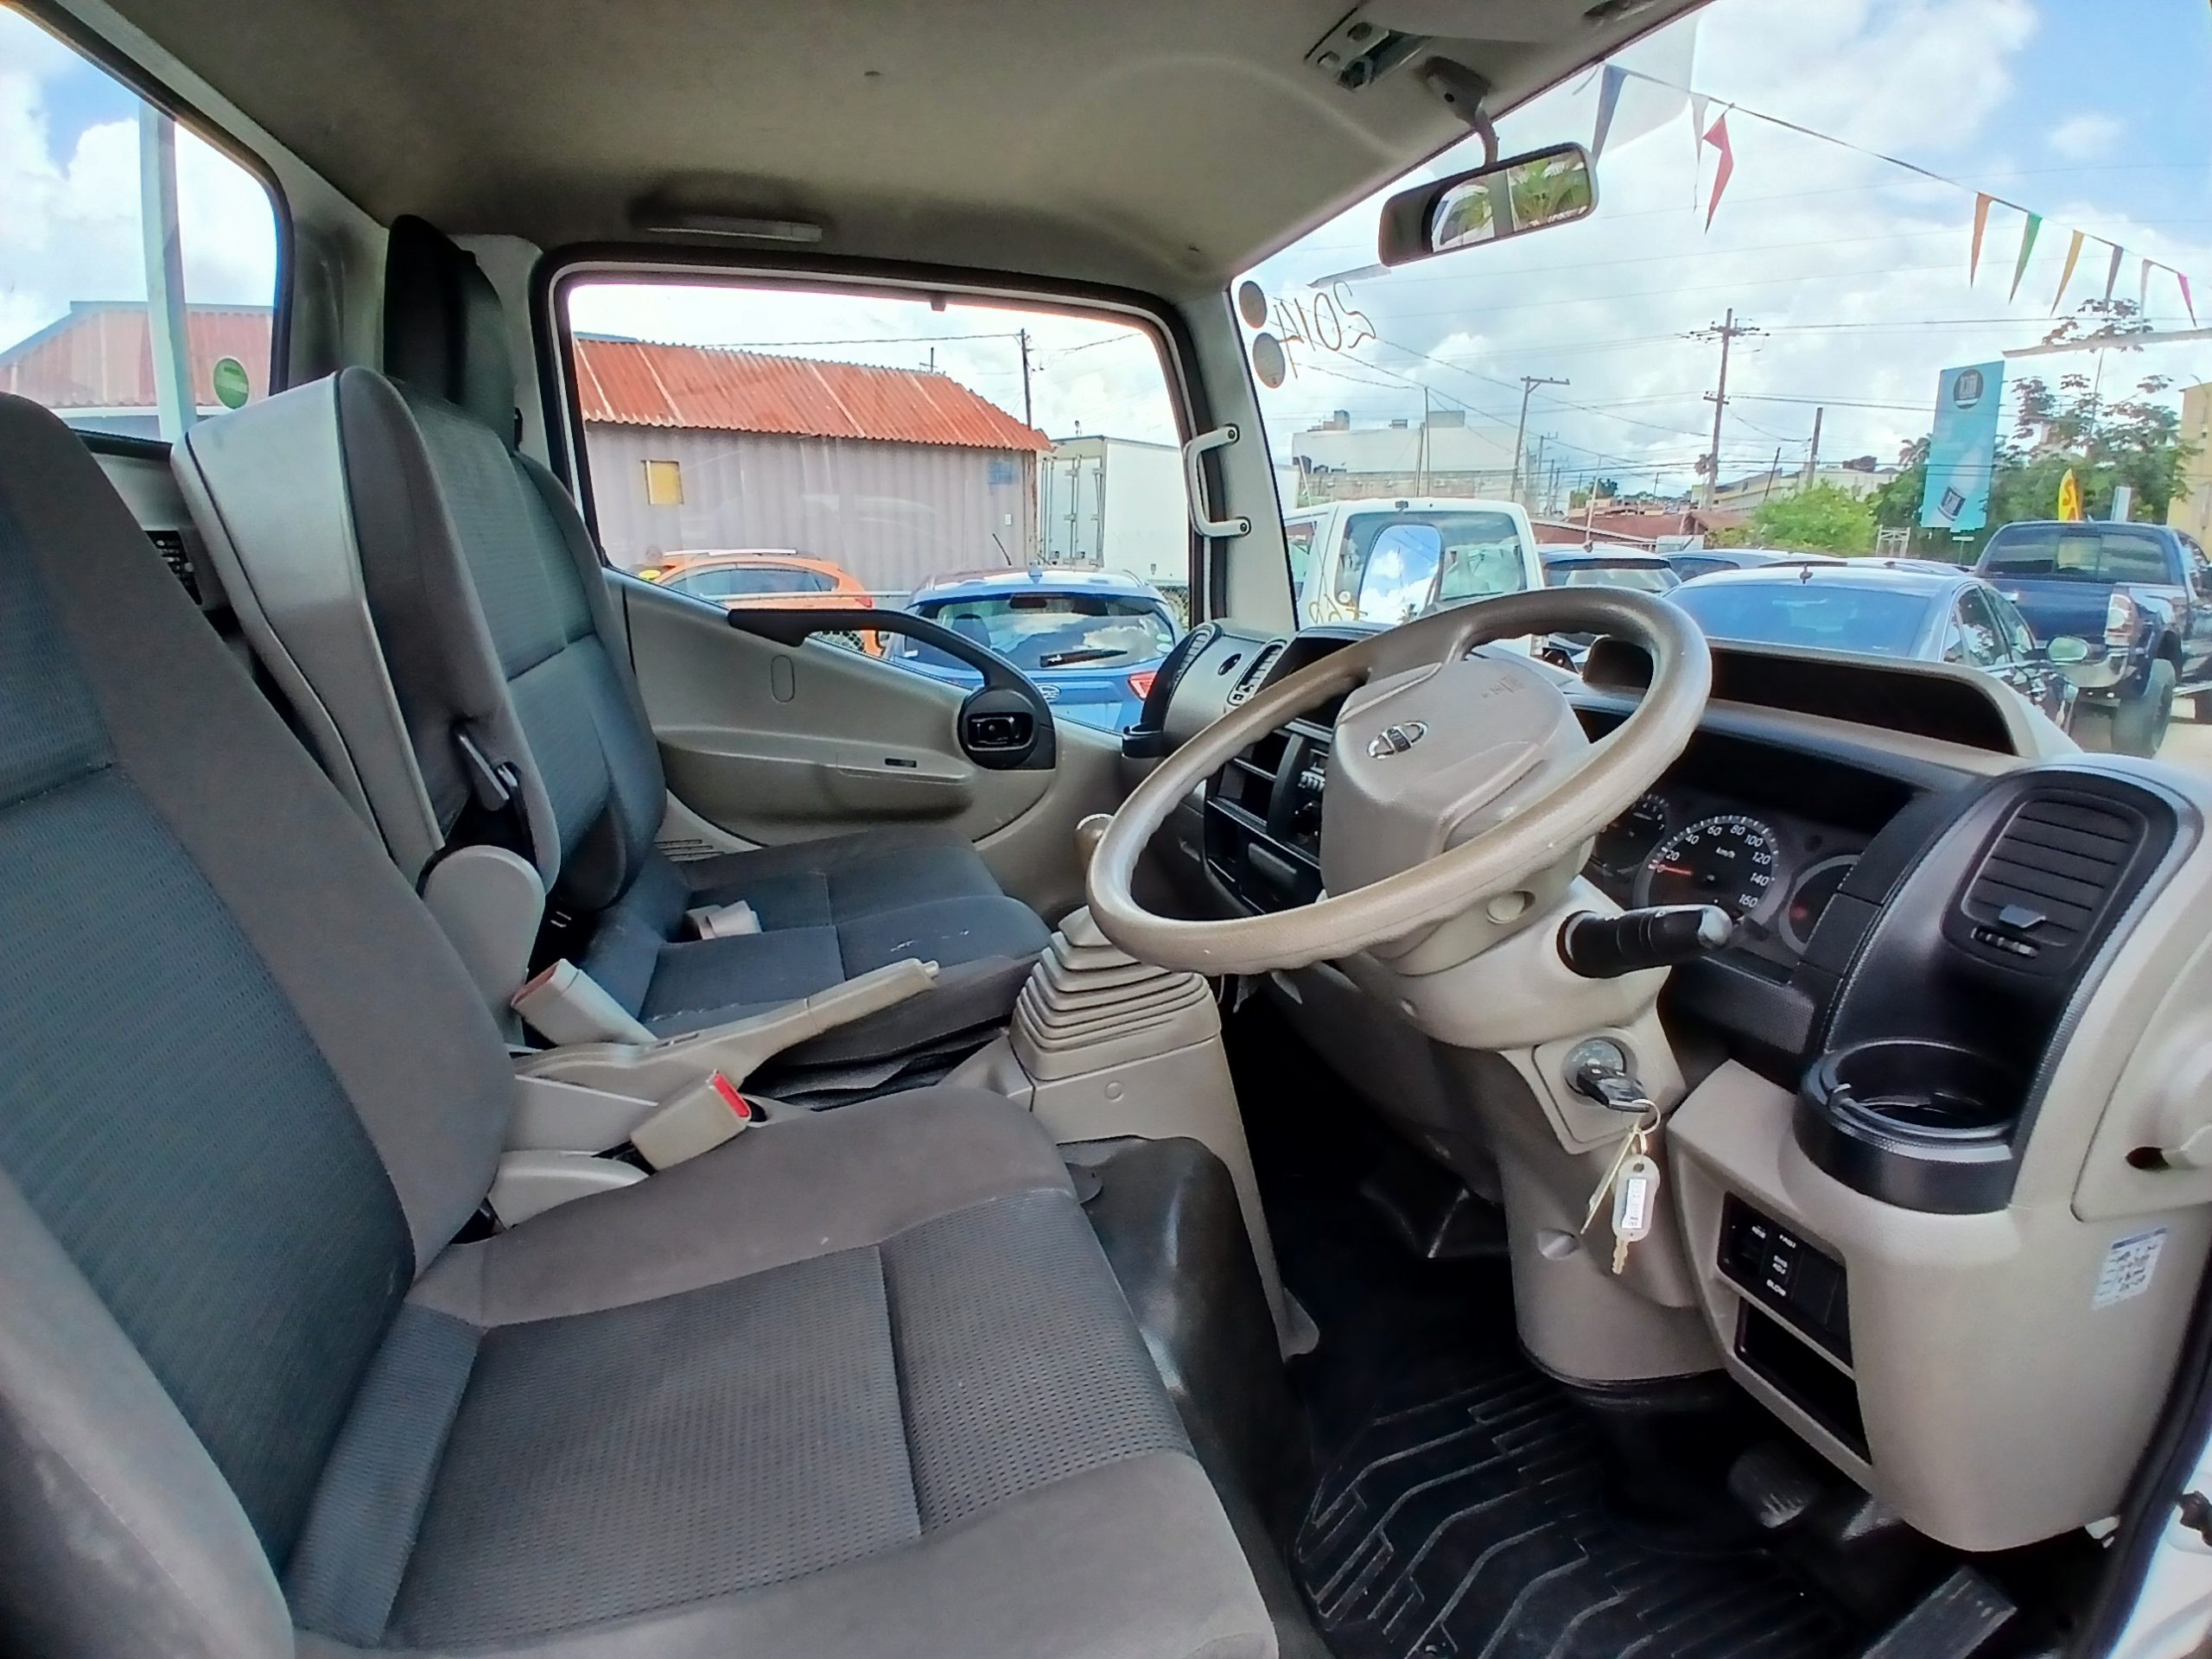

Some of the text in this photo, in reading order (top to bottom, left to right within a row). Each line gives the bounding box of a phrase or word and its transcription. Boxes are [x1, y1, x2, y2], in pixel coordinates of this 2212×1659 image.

[1707, 825, 1722, 836] 60
[1730, 824, 1745, 836] 80
[1685, 834, 1700, 844] 40
[1745, 835, 1764, 847] 100
[1666, 850, 1680, 861] 20
[1716, 847, 1736, 859] km/h
[1752, 852, 1771, 865] 120
[1750, 872, 1770, 887] 140
[1738, 893, 1758, 908] 160
